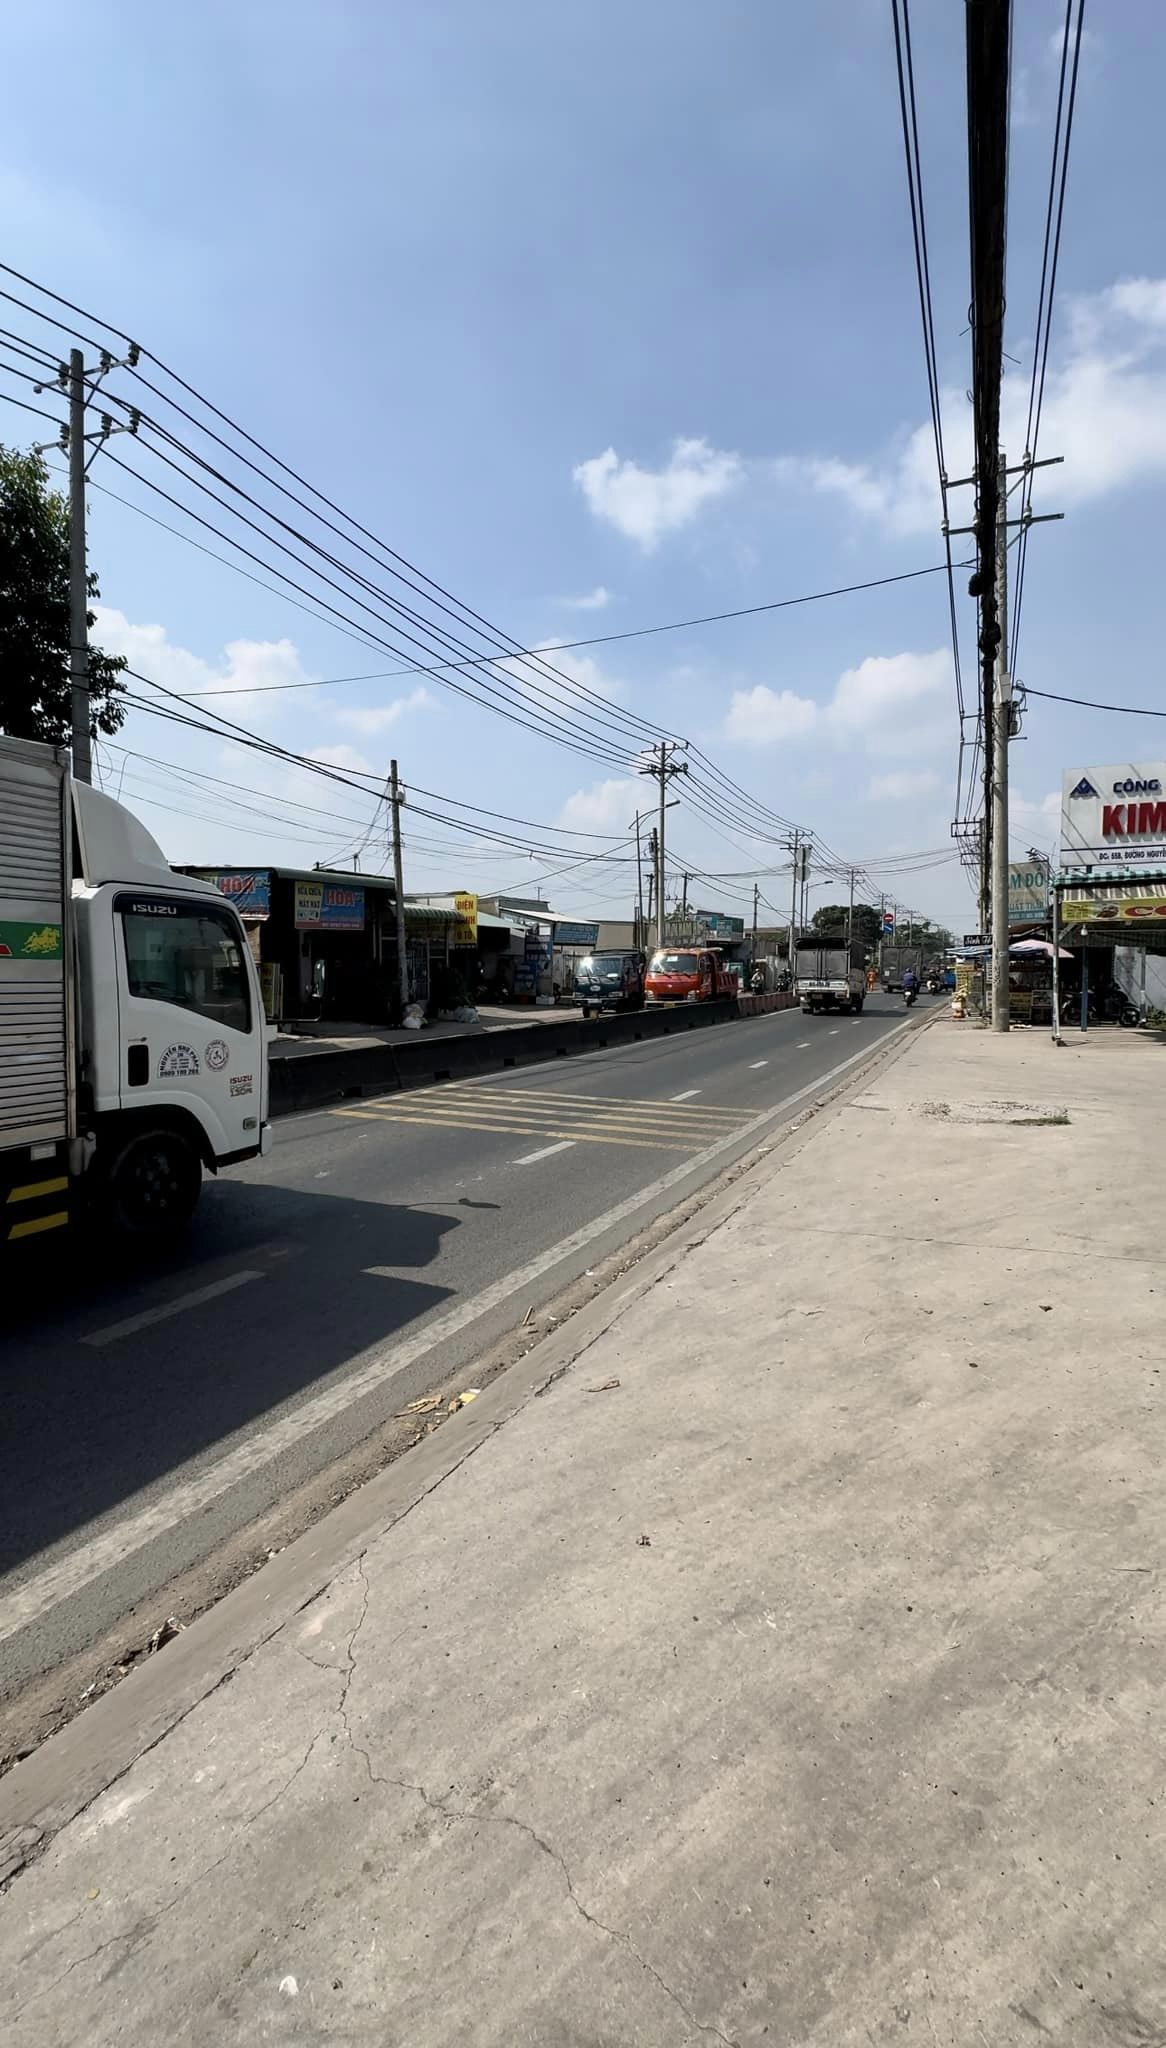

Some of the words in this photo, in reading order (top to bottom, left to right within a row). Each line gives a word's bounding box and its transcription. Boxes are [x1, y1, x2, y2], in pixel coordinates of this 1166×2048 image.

[1112, 778, 1160, 793] CÔNG
[1102, 801, 1166, 837] KIM
[132, 903, 177, 915] ISUZU
[229, 1075, 253, 1084] ISUZU
